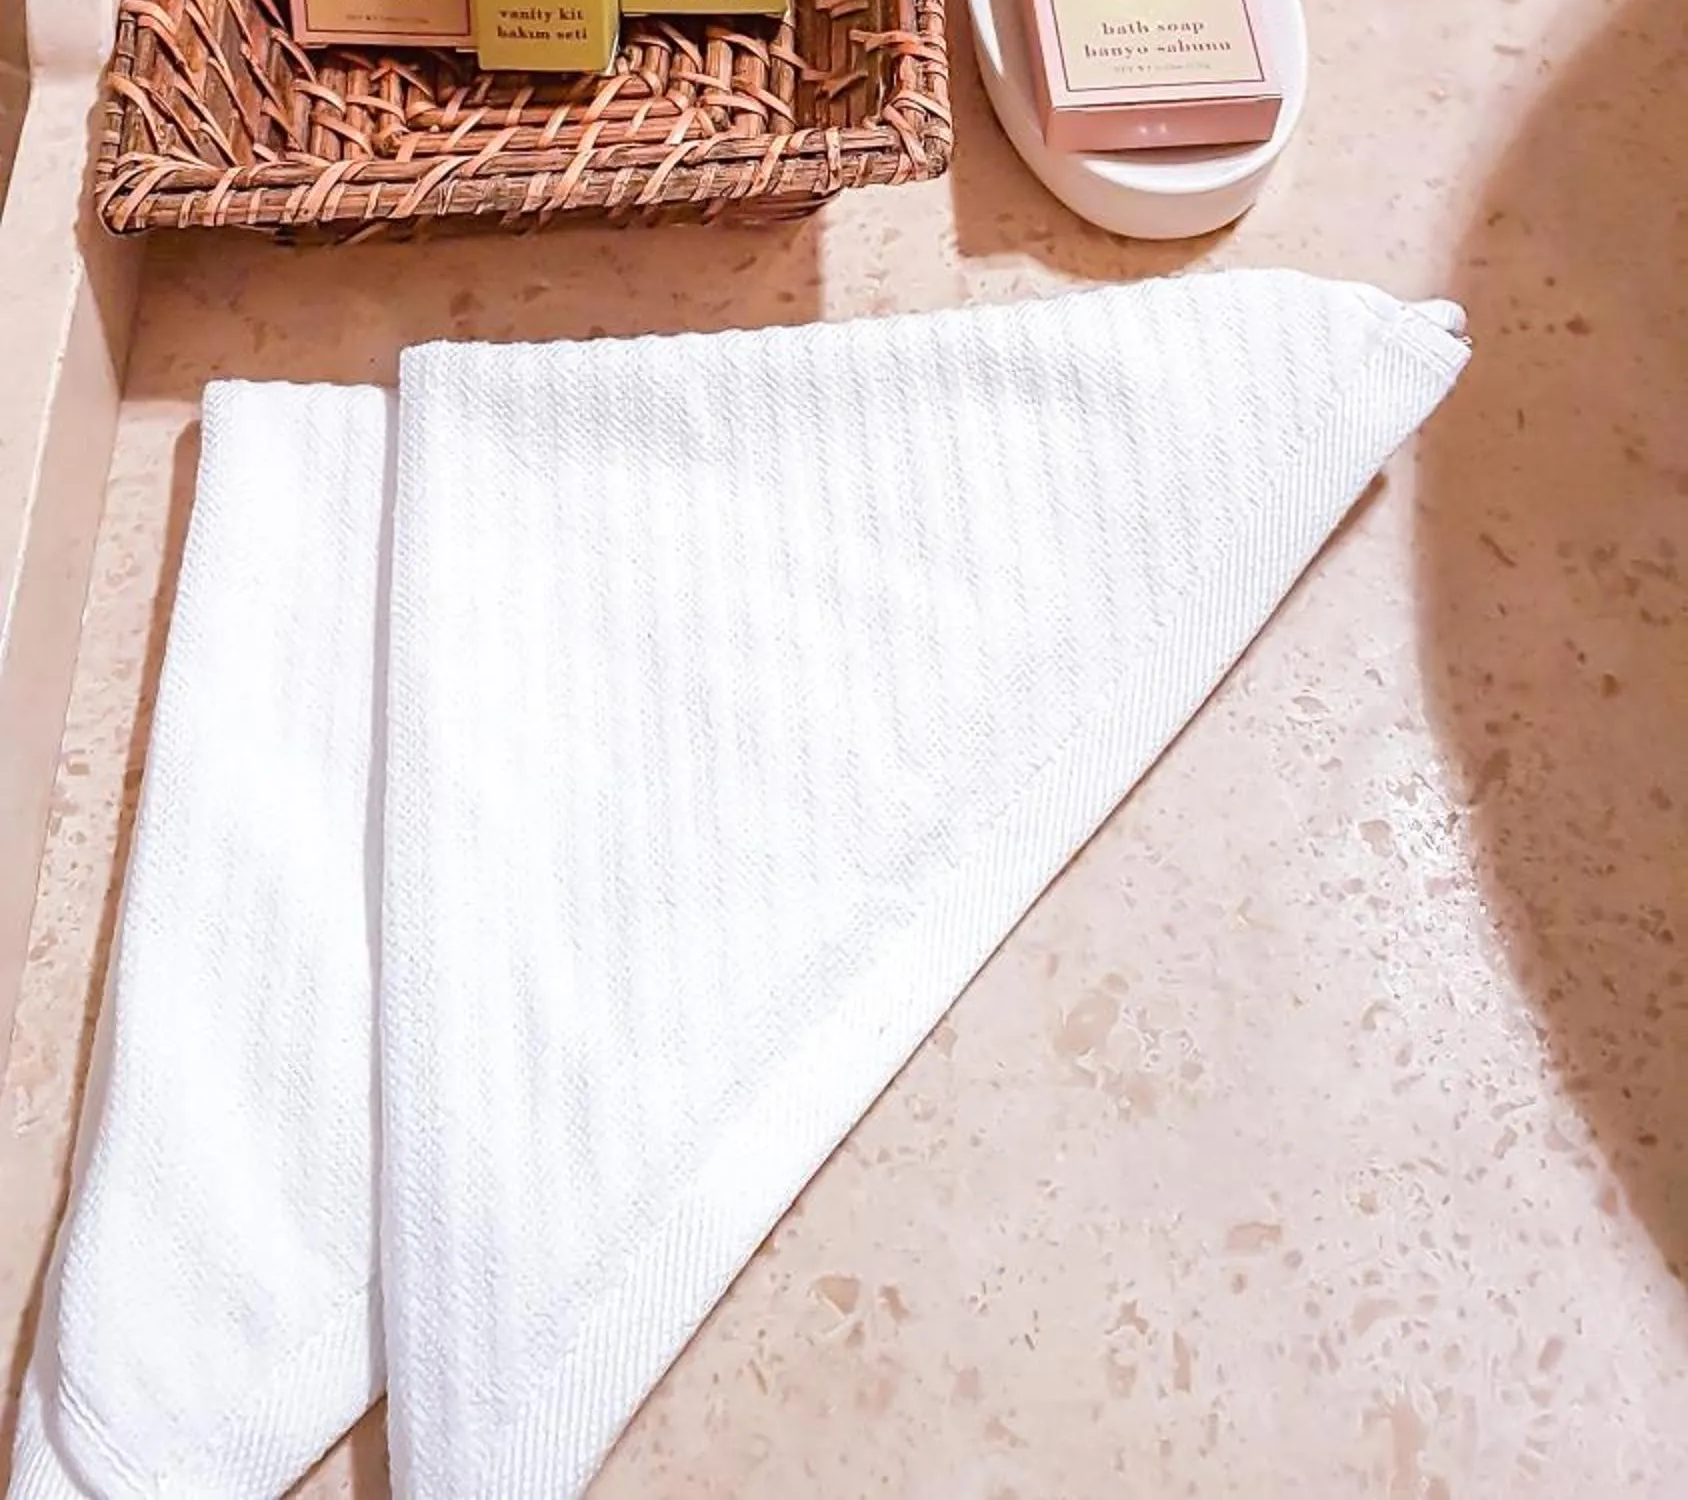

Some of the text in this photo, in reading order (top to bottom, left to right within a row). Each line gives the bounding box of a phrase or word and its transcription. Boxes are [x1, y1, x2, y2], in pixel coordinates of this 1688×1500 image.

[499, 6, 585, 24] vanity kit
[556, 27, 588, 42] seti
[1102, 19, 1205, 36] bath soap
[1083, 44, 1150, 60] banyo
